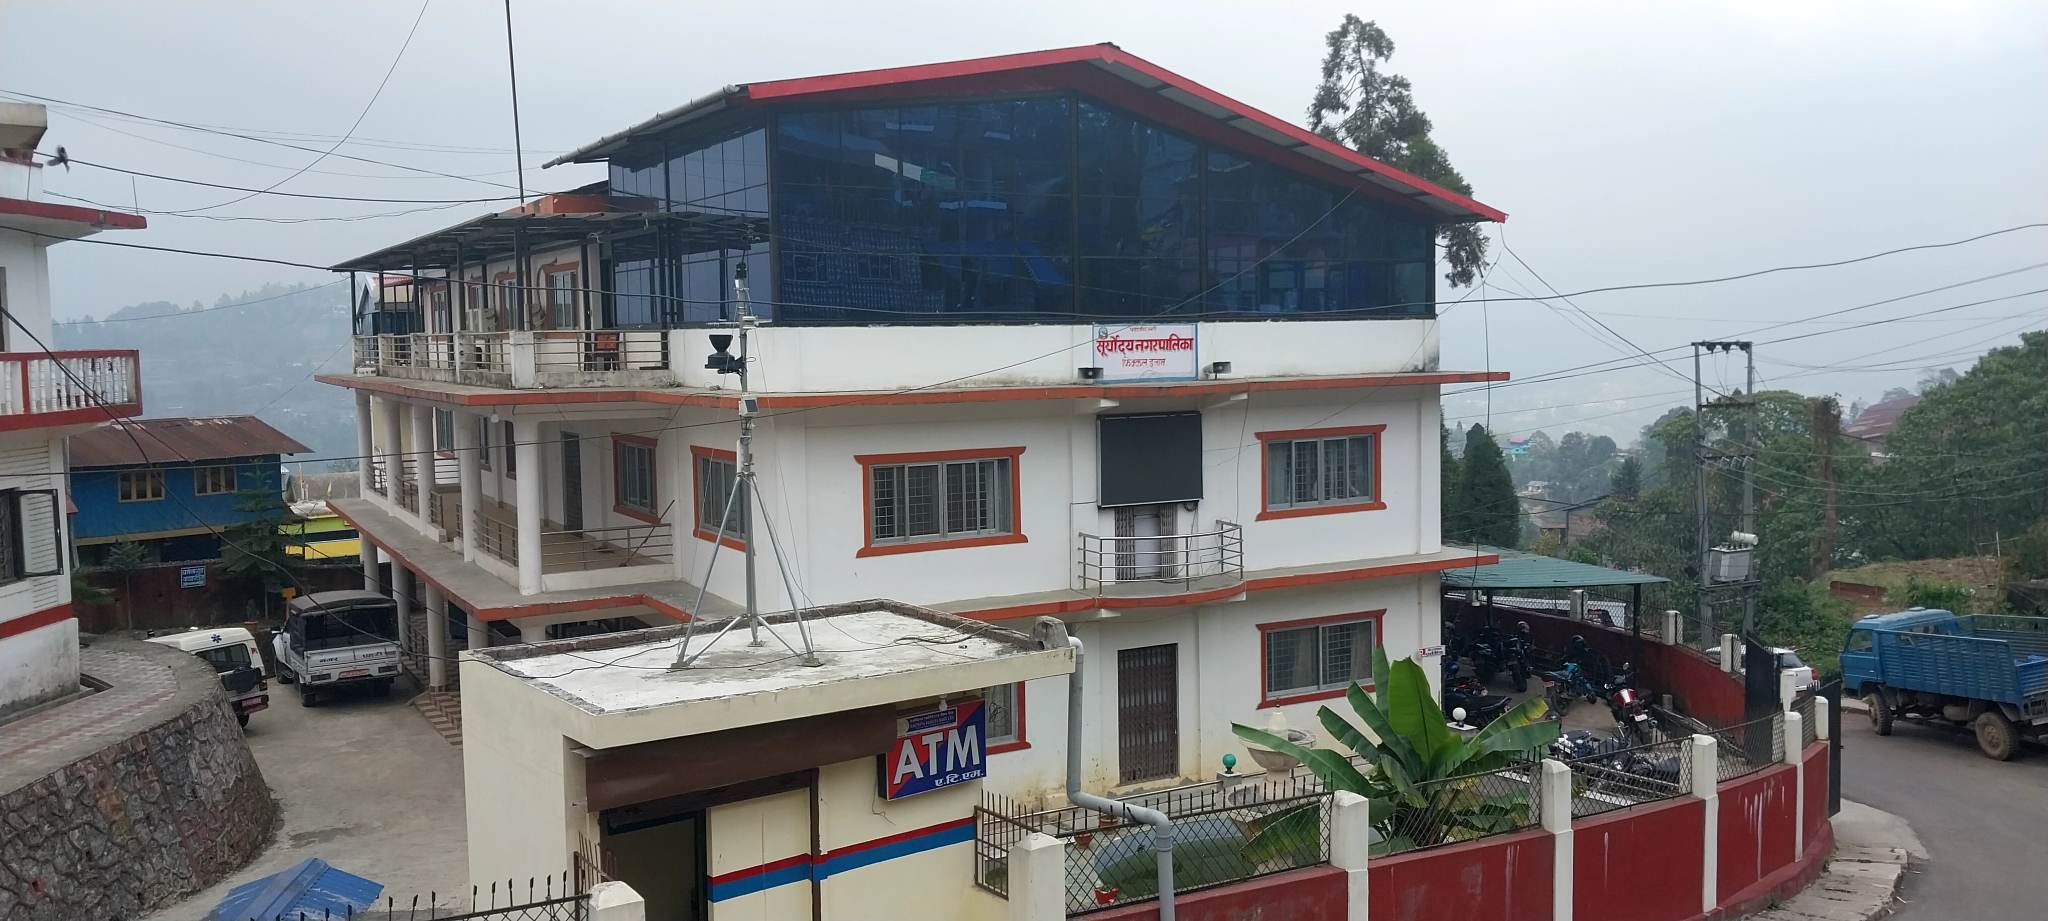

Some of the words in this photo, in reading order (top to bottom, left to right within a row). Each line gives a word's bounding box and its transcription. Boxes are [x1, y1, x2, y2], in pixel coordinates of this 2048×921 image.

[1096, 334, 1134, 357] सूर्योदय
[1135, 333, 1194, 352] नगरपालिका
[893, 725, 980, 785] ATM
